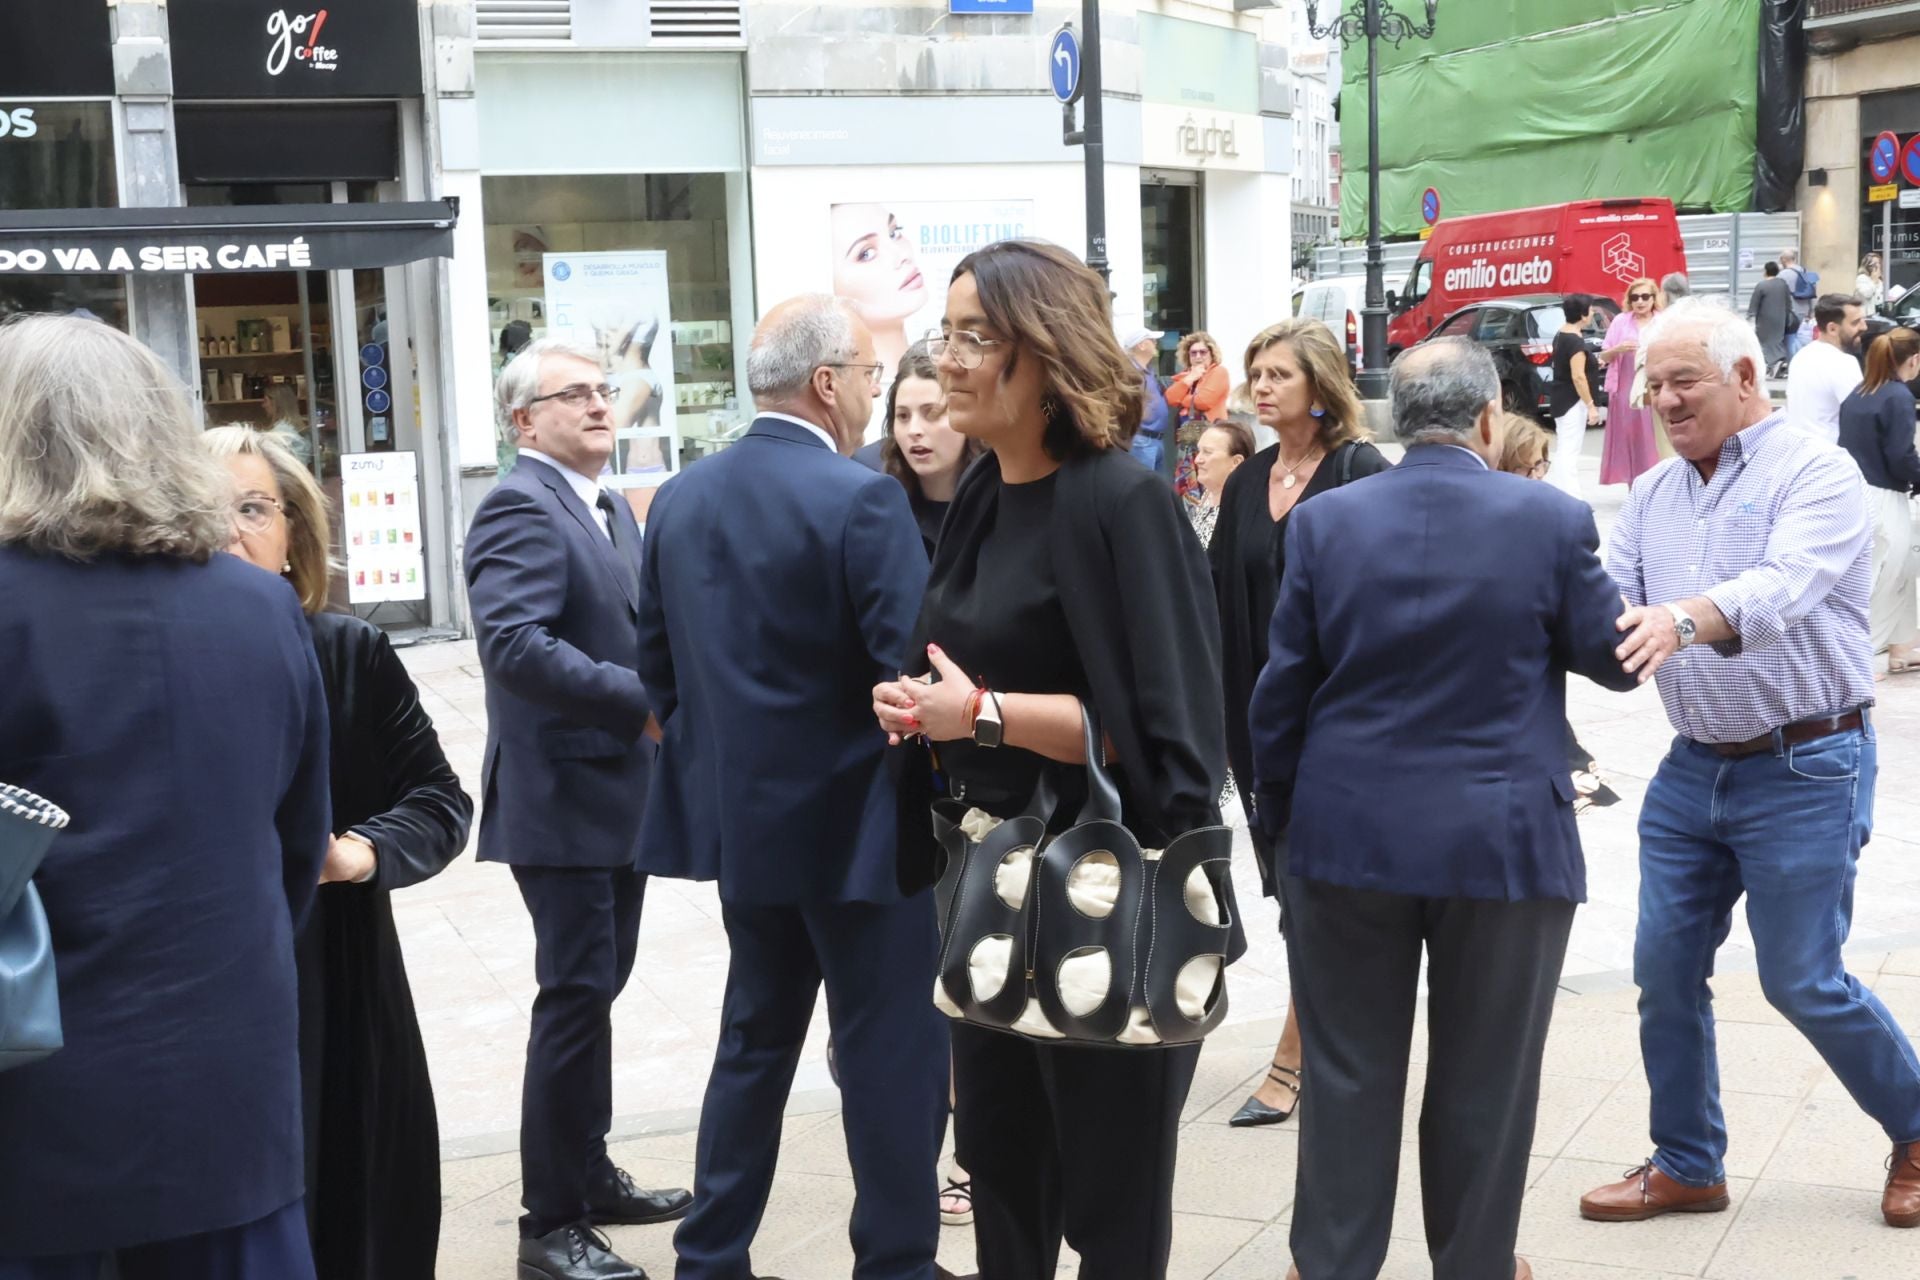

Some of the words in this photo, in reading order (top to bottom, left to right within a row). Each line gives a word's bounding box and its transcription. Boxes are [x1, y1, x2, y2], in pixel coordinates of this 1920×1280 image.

[920, 222, 1025, 245] BIOLIFTING
[1448, 235, 1555, 256] CONSTRUCCIONES
[52, 248, 101, 271] VA
[107, 247, 135, 270] A
[139, 246, 212, 271] SER
[216, 236, 312, 269] CAFÉ
[1444, 258, 1497, 291] emilio
[1499, 255, 1553, 287] cueto
